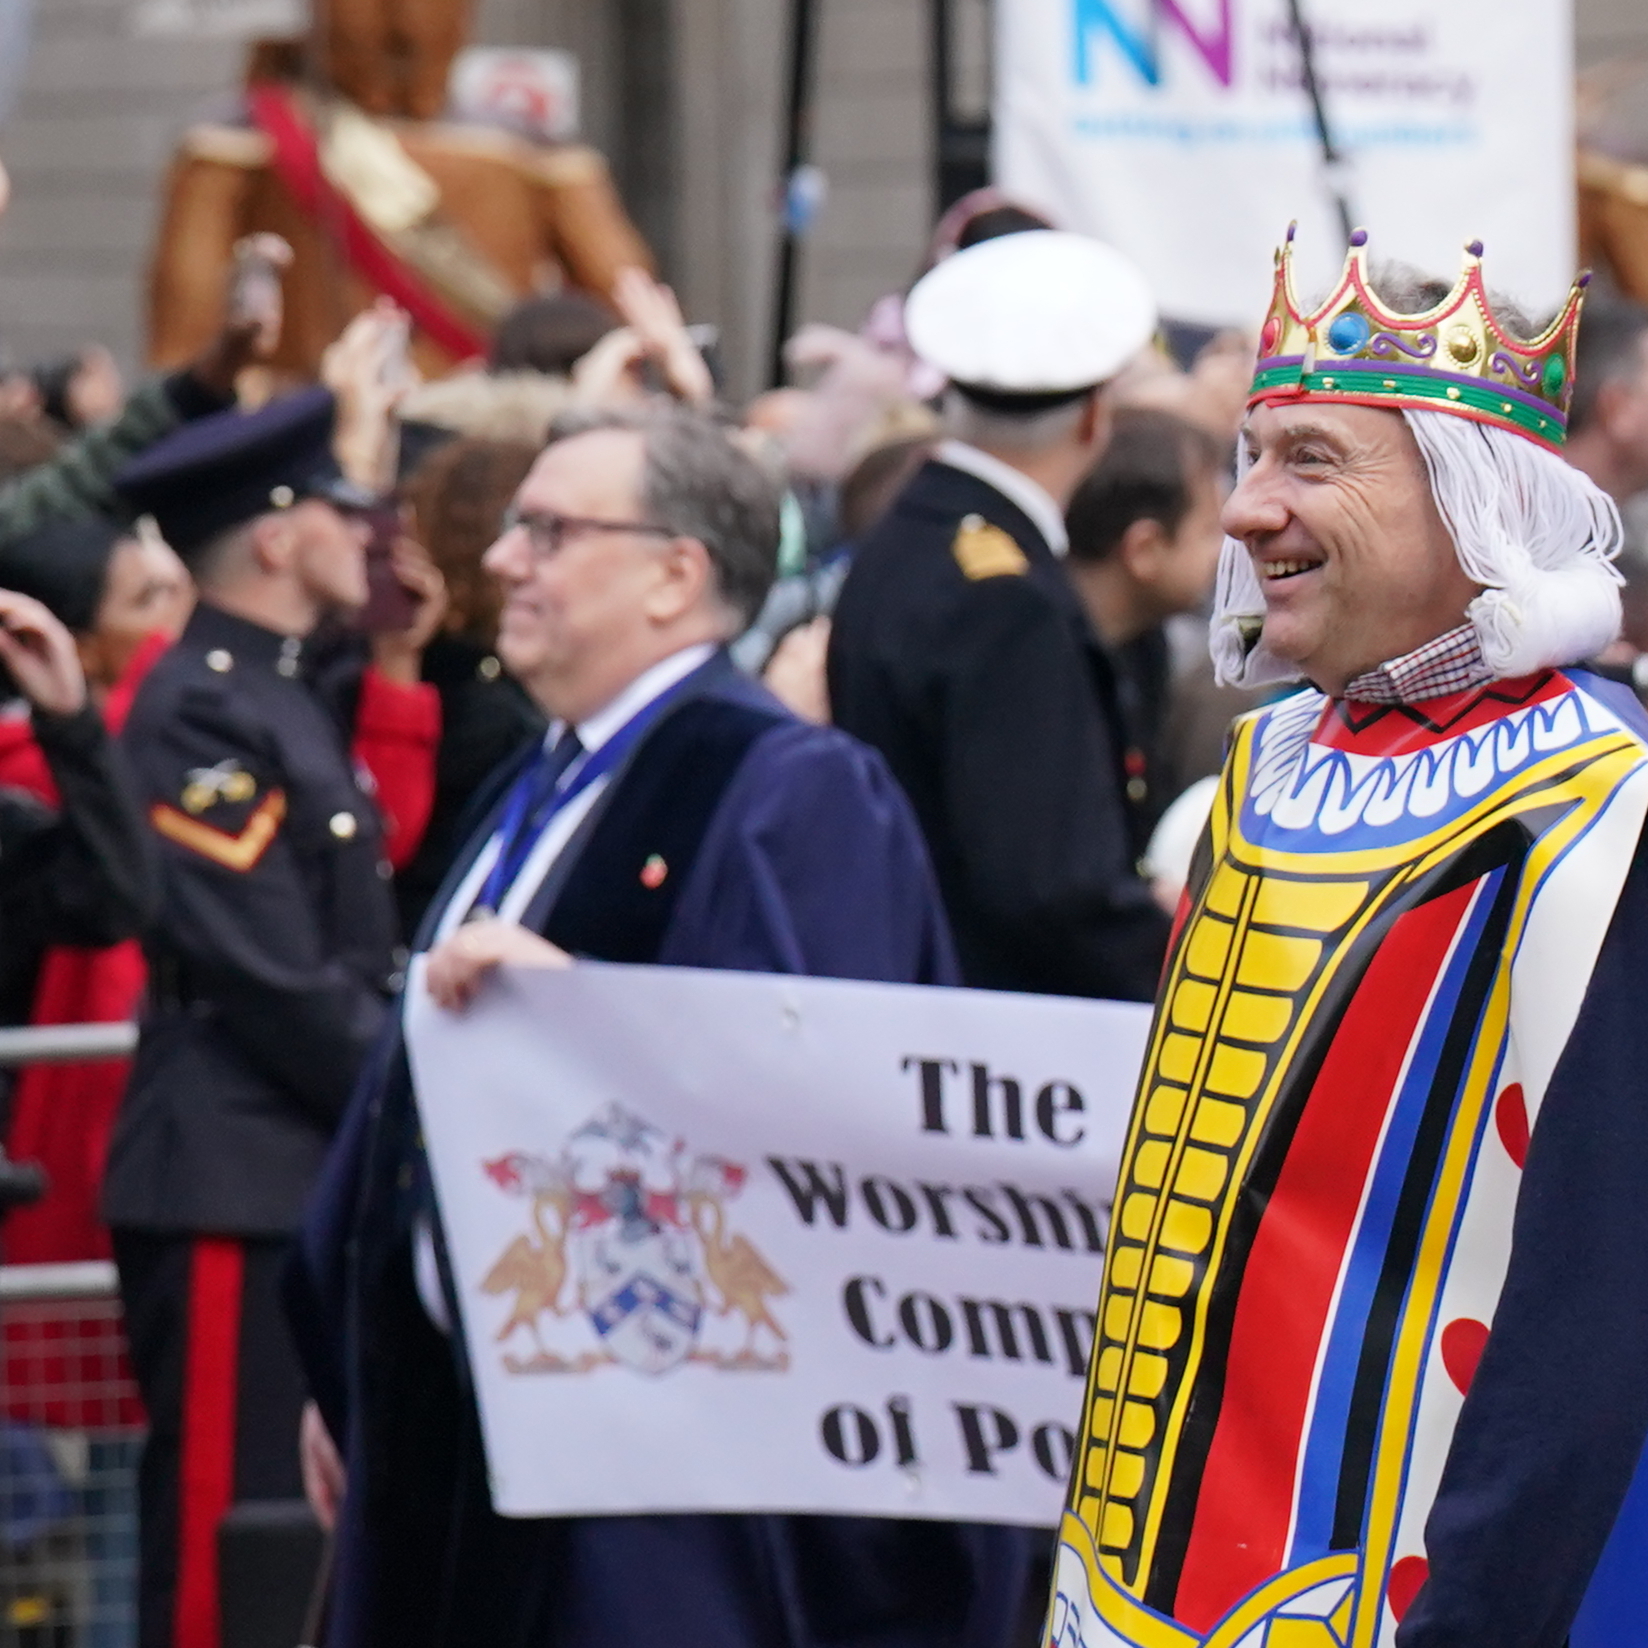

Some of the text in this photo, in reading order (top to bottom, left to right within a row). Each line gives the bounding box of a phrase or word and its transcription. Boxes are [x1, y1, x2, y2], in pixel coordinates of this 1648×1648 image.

[901, 1053, 1087, 1149] The
[765, 1153, 1113, 1255] Worshi
[839, 1272, 1098, 1381] Comp
[950, 1399, 1080, 1484] Po
